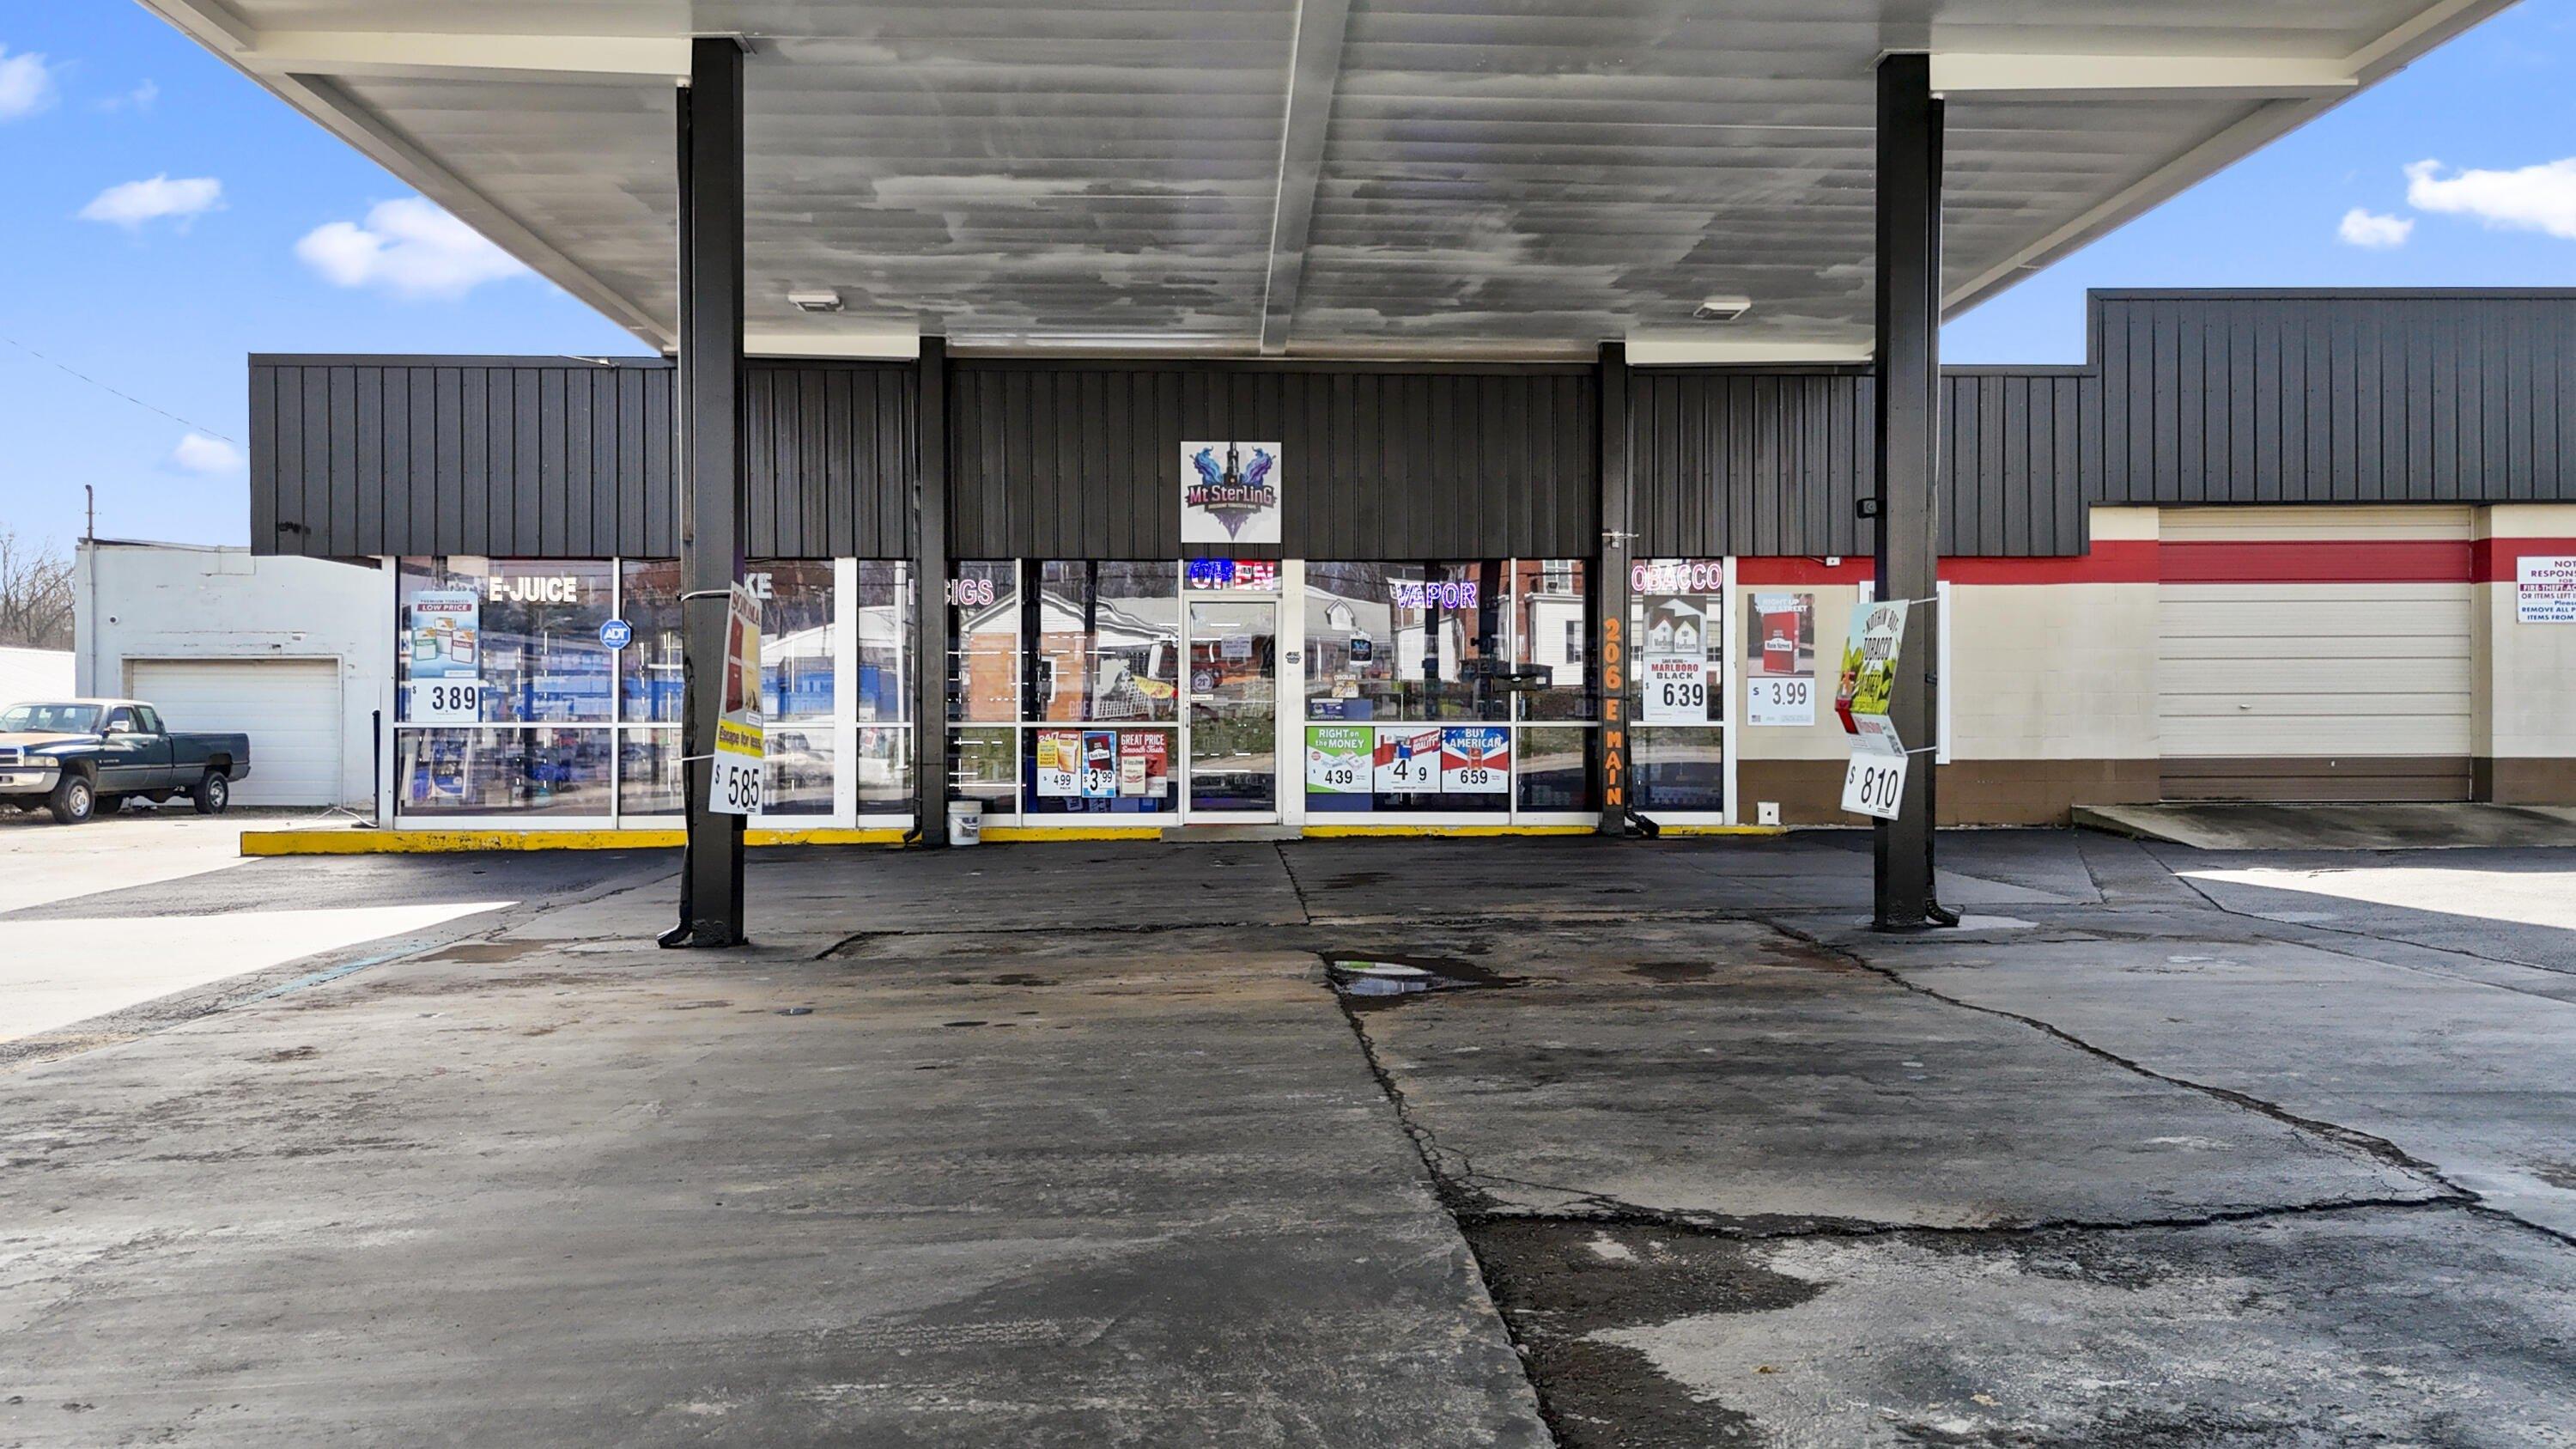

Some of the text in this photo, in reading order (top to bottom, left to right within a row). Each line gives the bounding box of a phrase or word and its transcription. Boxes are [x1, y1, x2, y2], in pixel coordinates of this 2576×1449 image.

[1189, 486, 1209, 503] Mt
[1191, 559, 1274, 591] OPEN
[1631, 563, 1722, 591] OBACCO
[489, 576, 577, 602] E-JUICE
[744, 572, 772, 600] KE
[1394, 581, 1477, 609] VAPOR
[604, 628, 627, 640] ADT
[1862, 637, 1893, 661] TOBACCO
[1651, 663, 1698, 672] MARLBORO
[1772, 682, 1807, 705] 3.99
[1604, 618, 1622, 806] 206 E MAIN
[1121, 734, 1165, 746] GREAT PRICE
[1319, 728, 1349, 738] RIGHT
[1449, 737, 1502, 747] AMERICAN
[1465, 728, 1486, 738] BUY
[1328, 740, 1364, 748] MONEY
